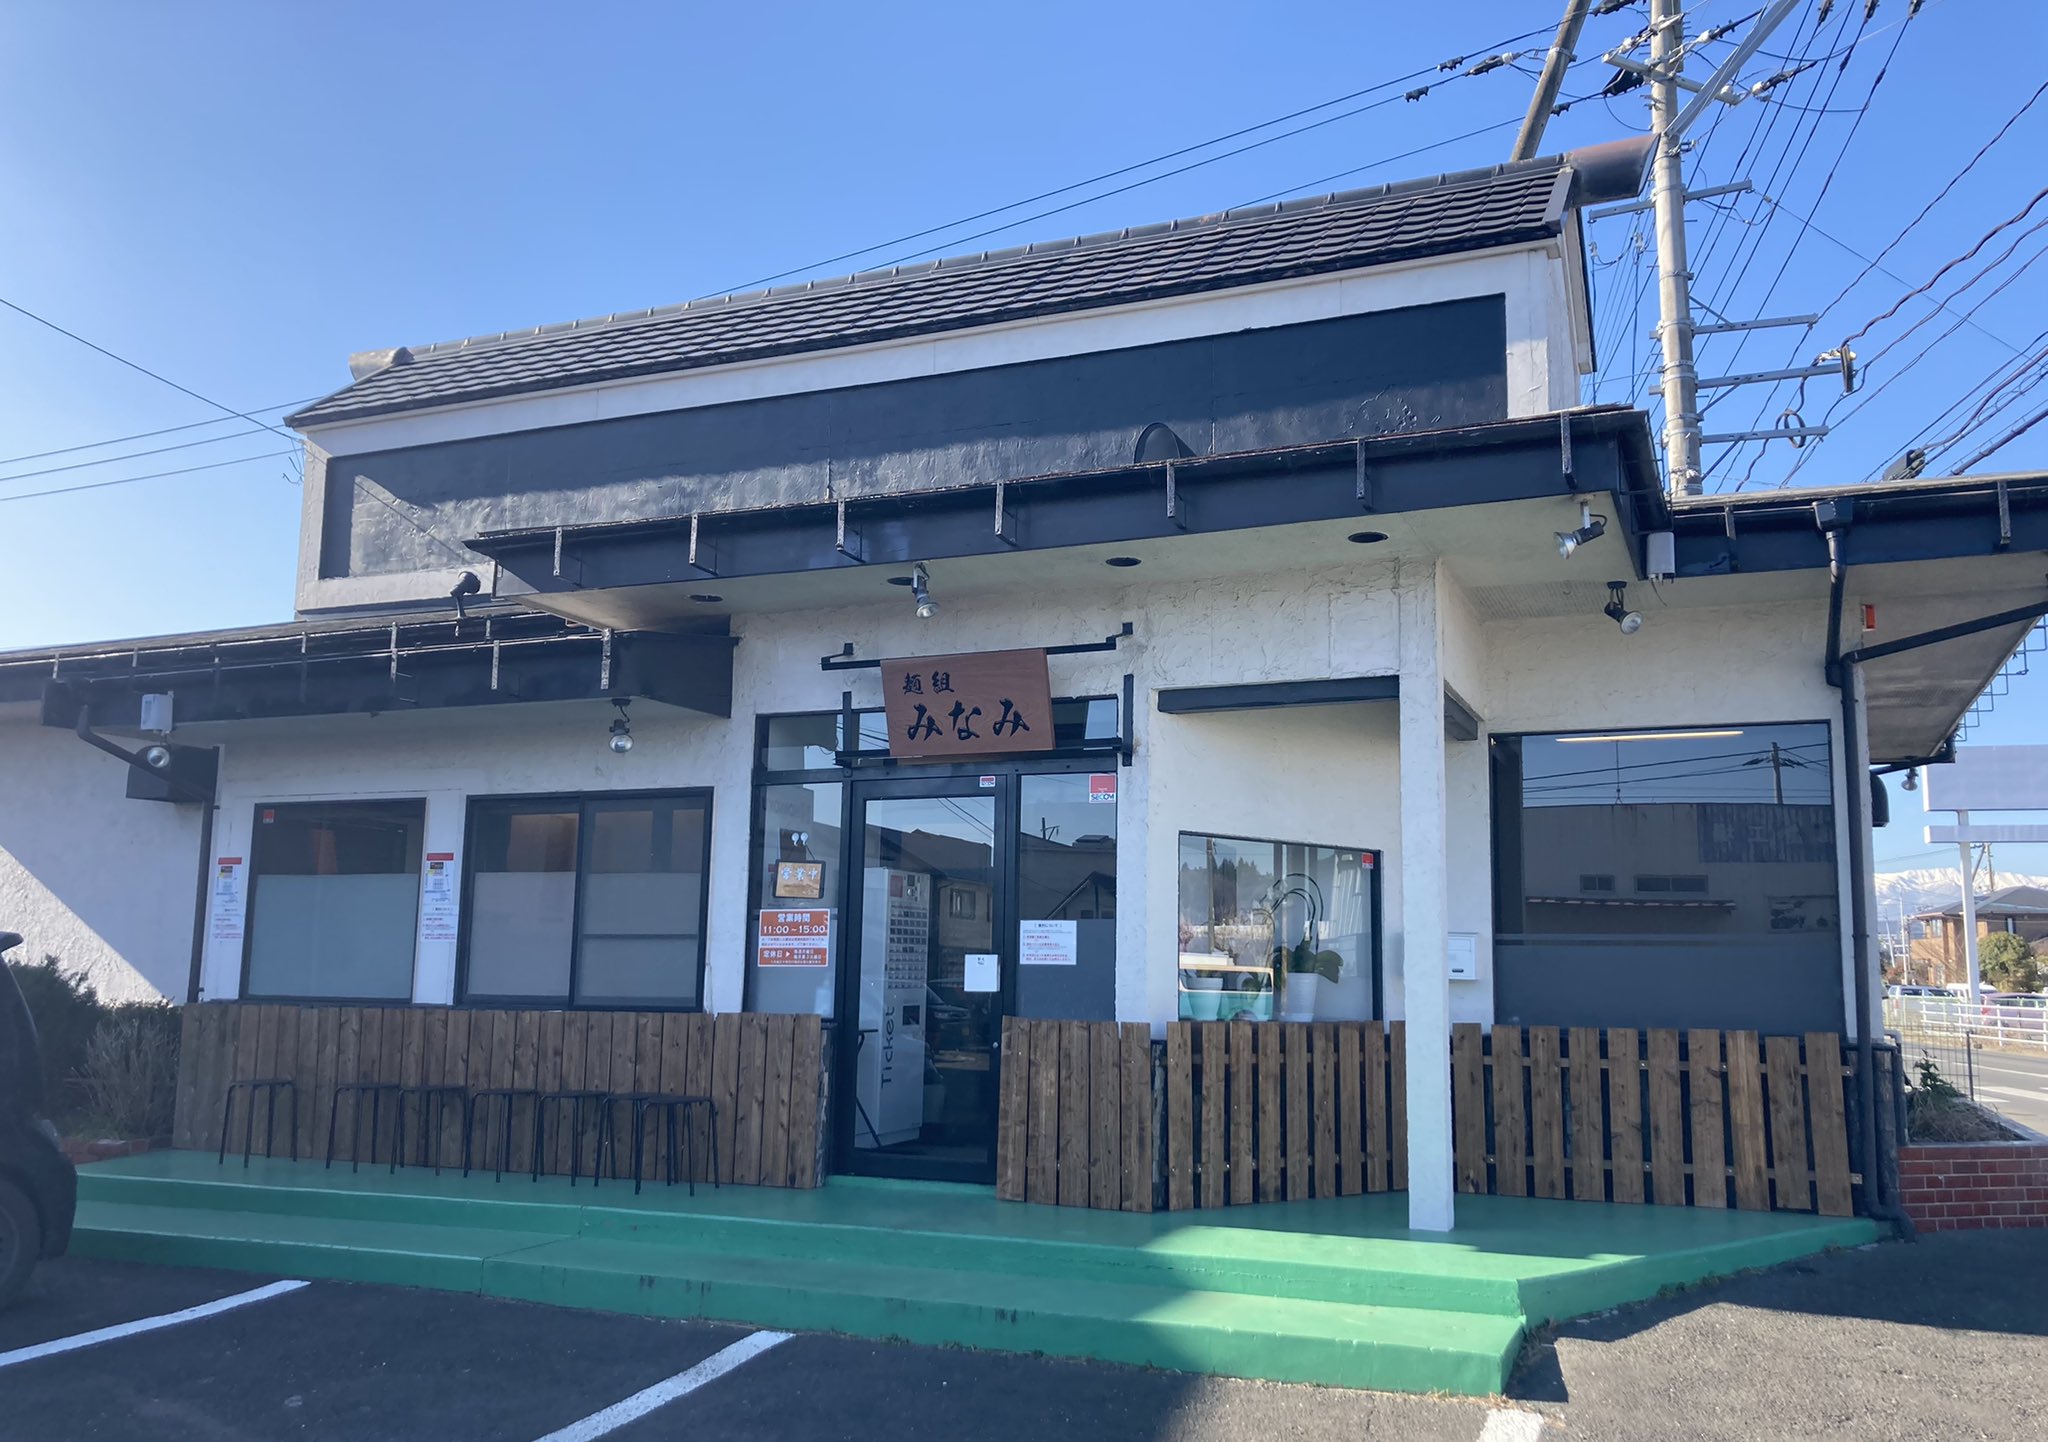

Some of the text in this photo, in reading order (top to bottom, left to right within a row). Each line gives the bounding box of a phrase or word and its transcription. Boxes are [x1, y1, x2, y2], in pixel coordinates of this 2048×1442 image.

[902, 670, 955, 696] 麺組
[907, 698, 1030, 741] みなみ
[1091, 793, 1115, 801] SECOM
[777, 913, 811, 923] 営業時間
[763, 950, 783, 958] 定休日
[881, 1006, 895, 1088] Ticket
